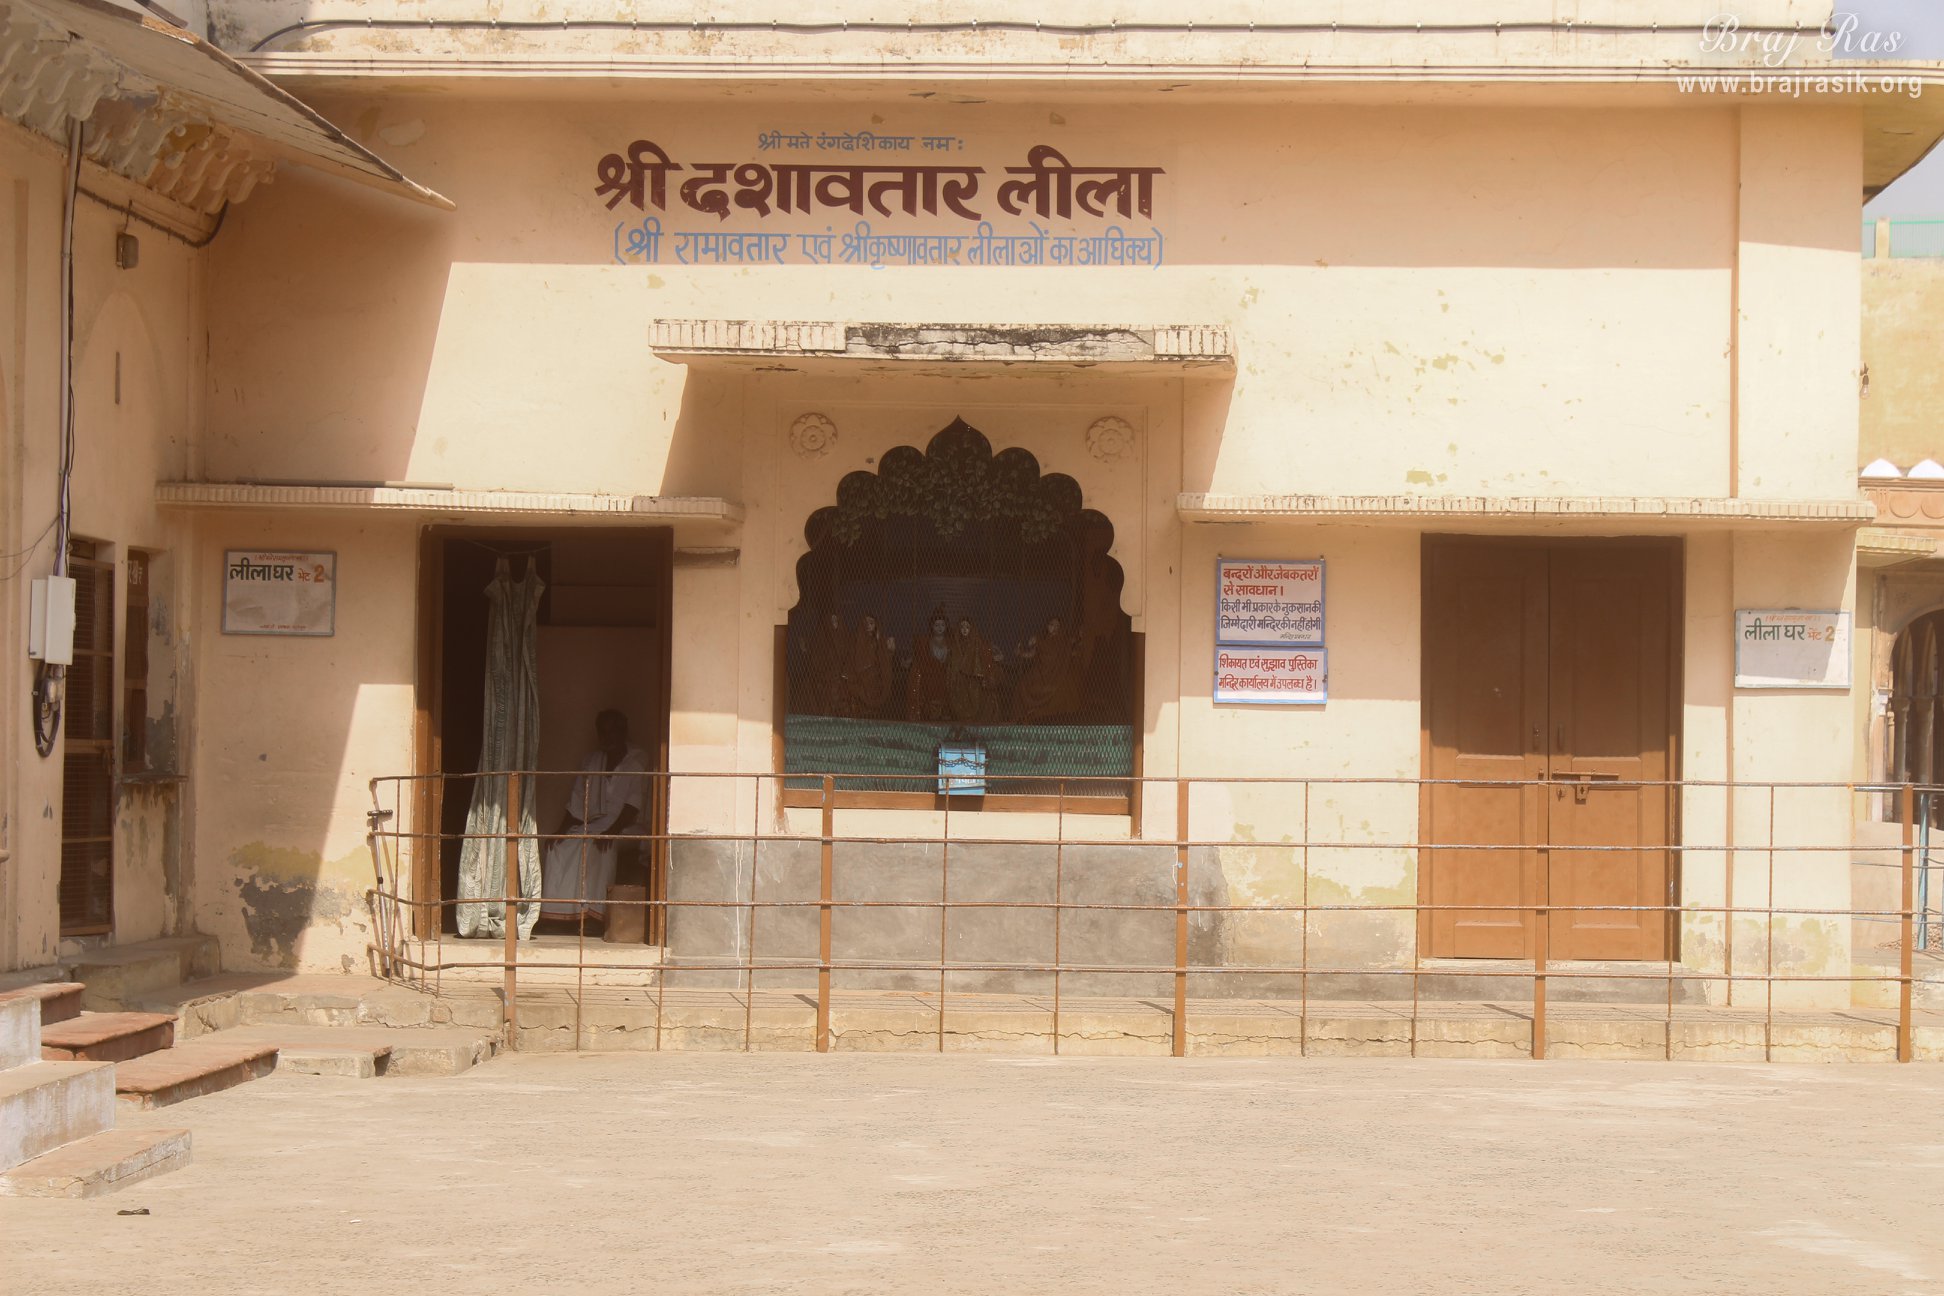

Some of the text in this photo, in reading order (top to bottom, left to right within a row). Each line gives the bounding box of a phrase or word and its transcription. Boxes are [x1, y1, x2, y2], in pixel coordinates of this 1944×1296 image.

[594, 139, 1167, 222] श्री दशावतार लीला
[673, 231, 792, 265] रामावतार
[796, 225, 837, 264] एवं
[230, 557, 273, 581] लीला
[313, 564, 325, 583] 2
[1745, 617, 1781, 641] लीला
[1783, 624, 1806, 641] घर
